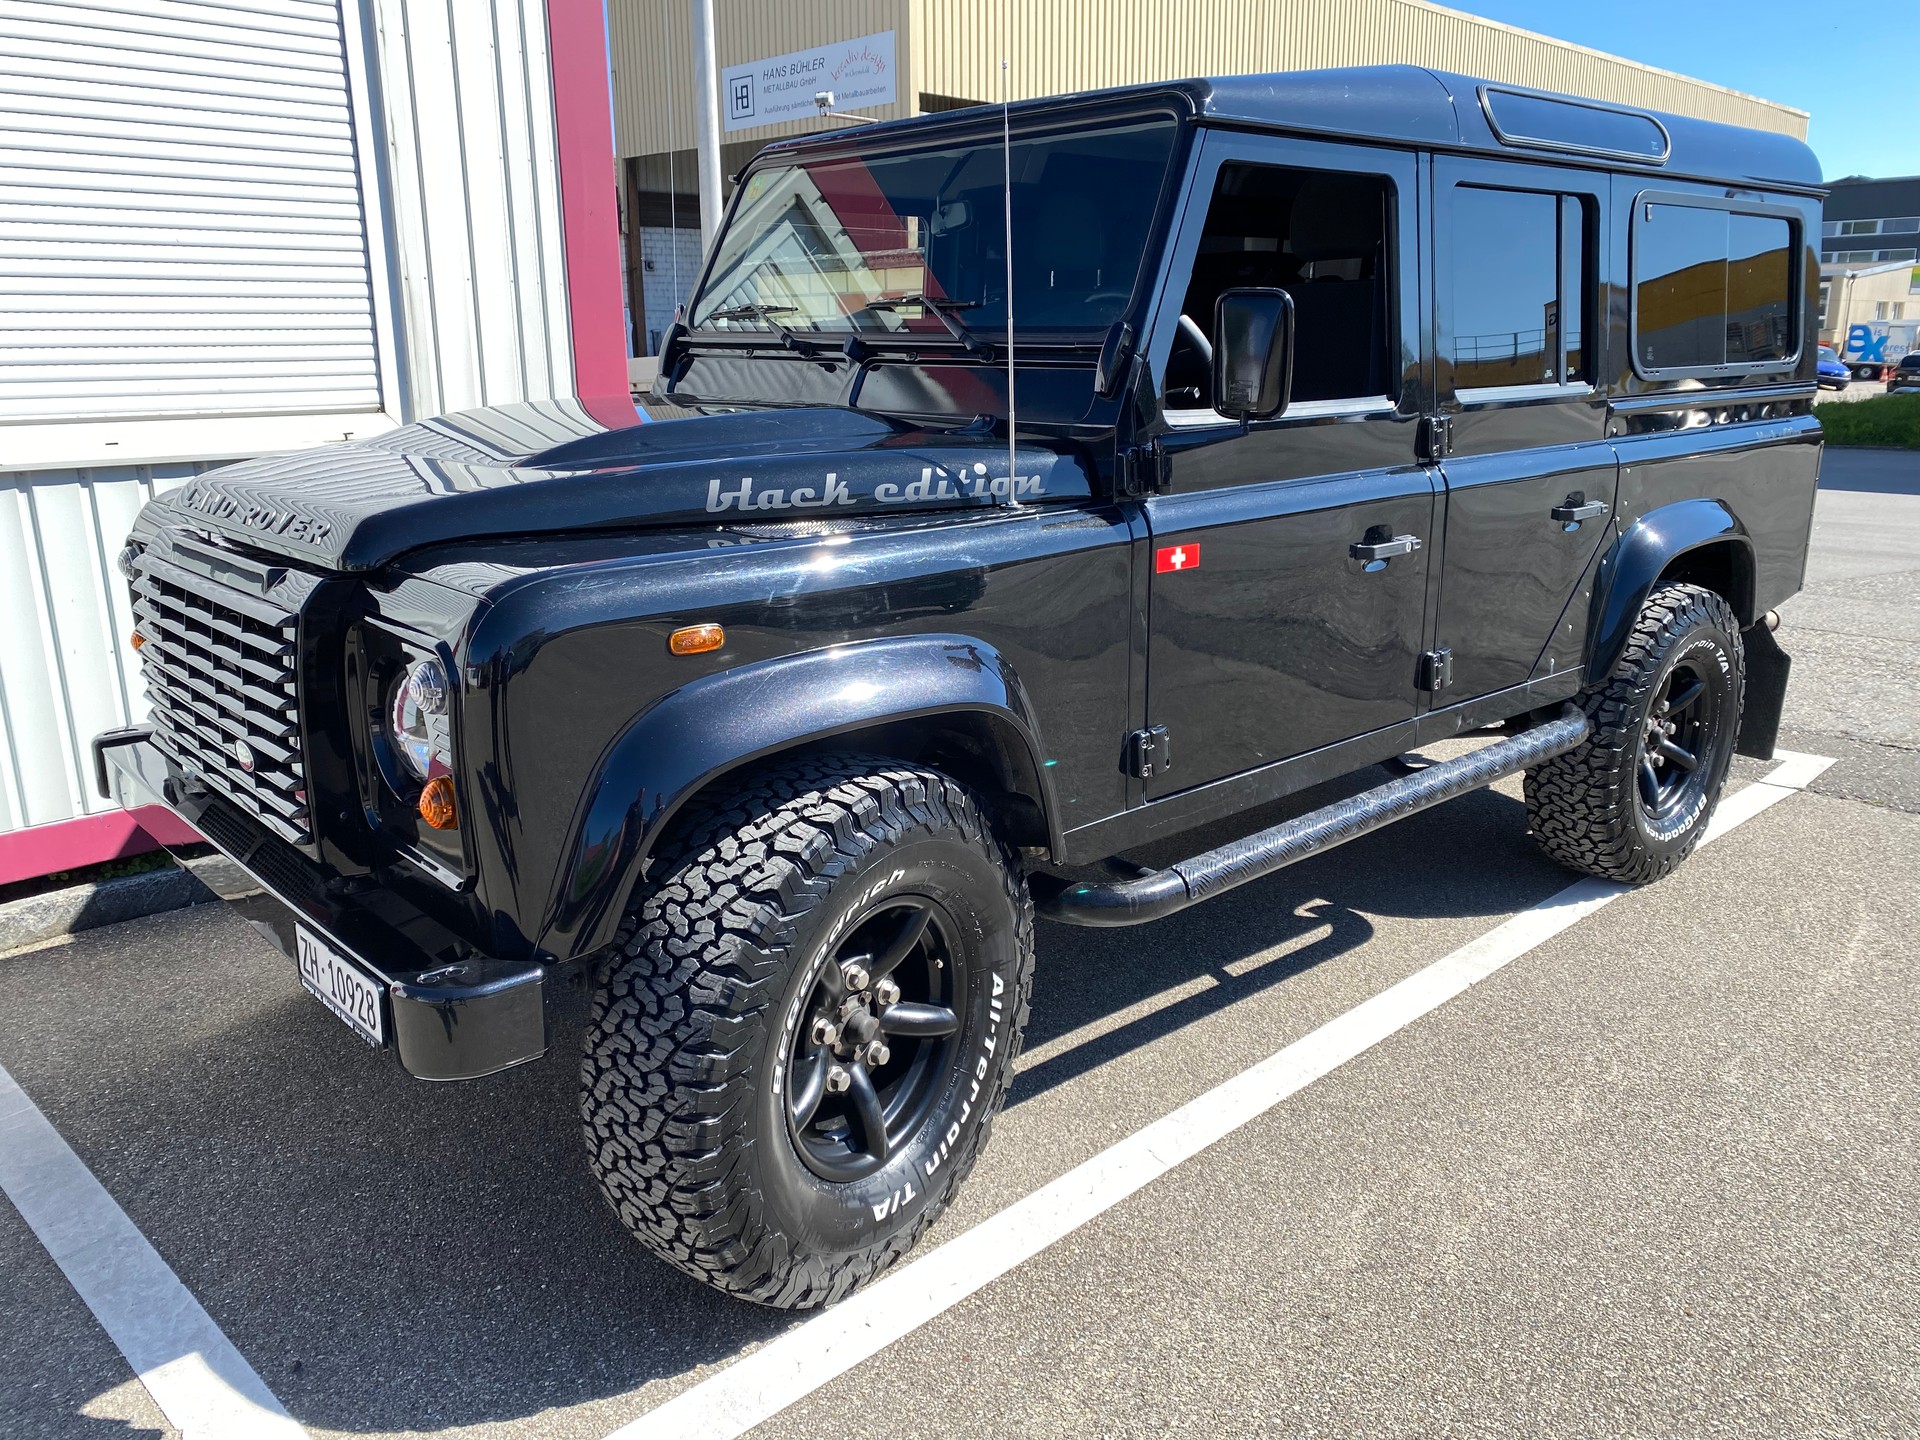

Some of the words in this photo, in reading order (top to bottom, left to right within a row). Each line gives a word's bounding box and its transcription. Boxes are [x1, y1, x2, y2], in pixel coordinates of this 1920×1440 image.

[763, 65, 787, 81] HANS
[790, 57, 825, 75] BÜHLER
[763, 79, 798, 94] METALLBAU
[800, 76, 817, 88] GmbH
[764, 102, 791, 114] Ausführung
[706, 473, 857, 513] black
[874, 462, 1046, 503] edition
[186, 488, 238, 519] LAND
[242, 505, 332, 546] ROVER
[1644, 793, 1708, 842] BFGoodrich
[772, 868, 905, 1094] BFGoodrich
[925, 972, 1004, 1176] All-Terrain
[872, 1182, 916, 1221] T/A
